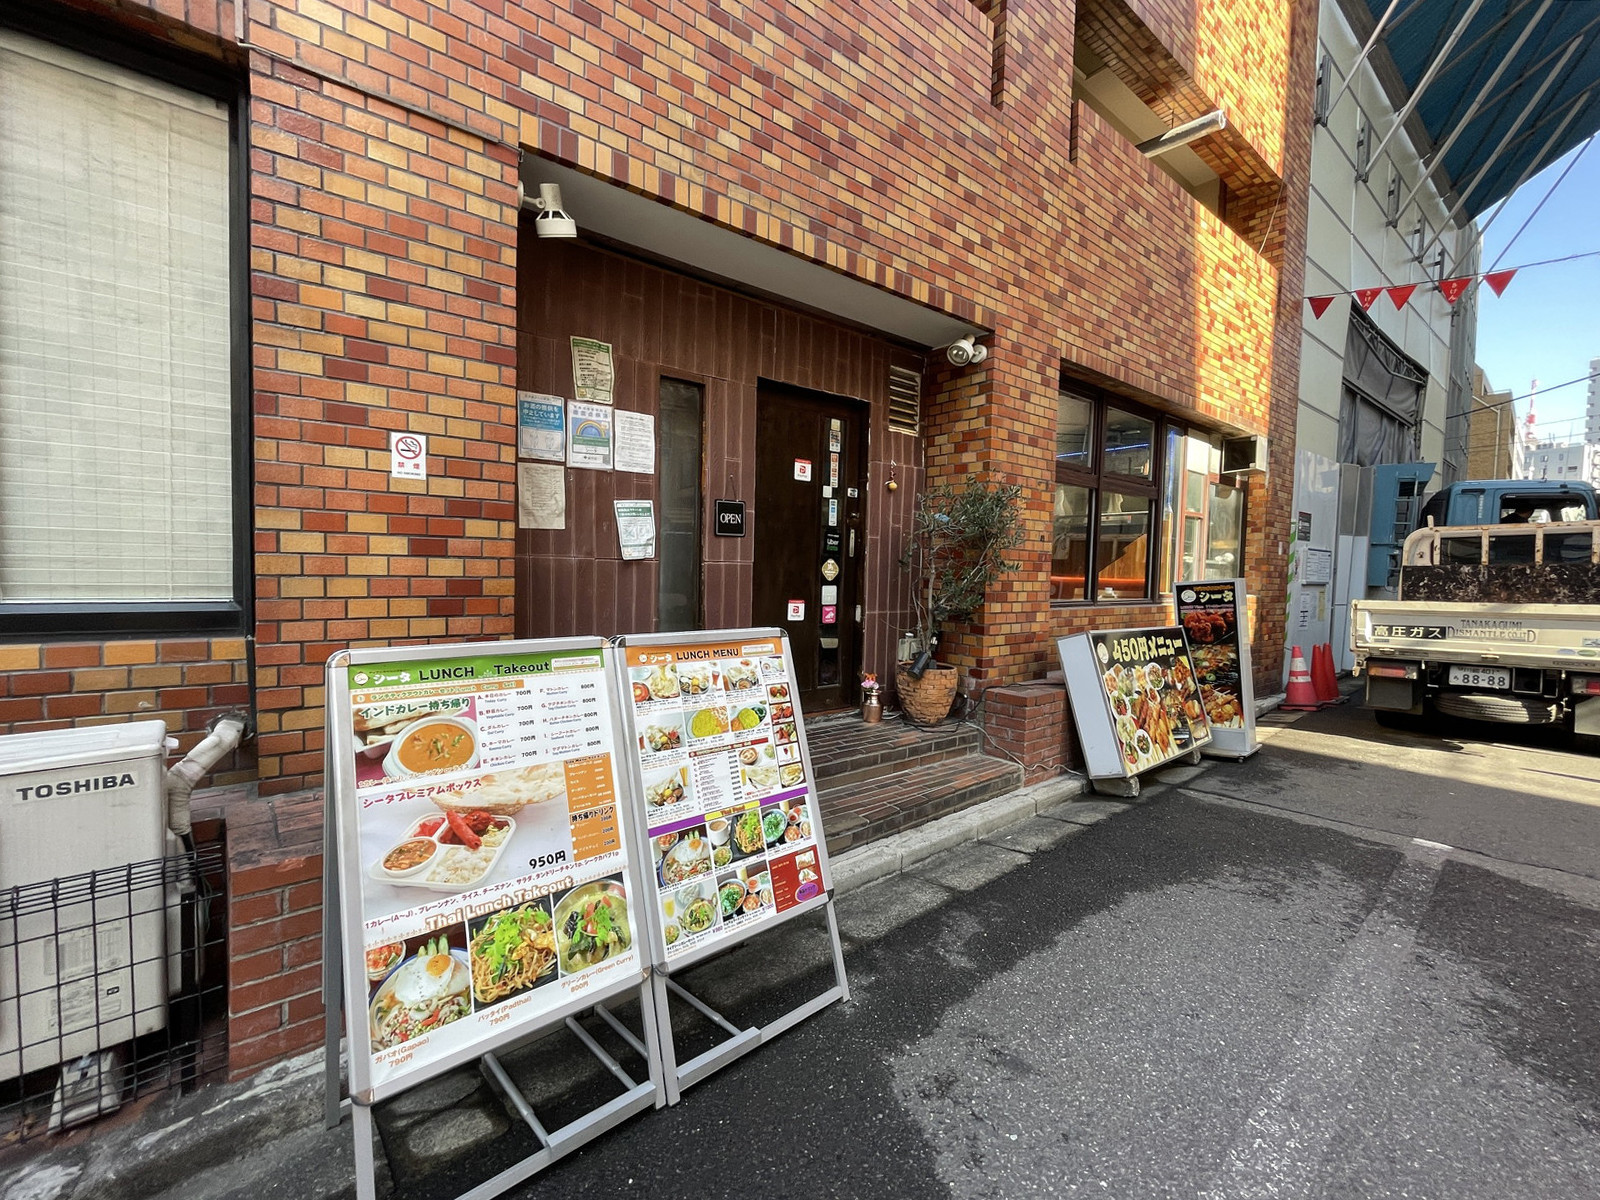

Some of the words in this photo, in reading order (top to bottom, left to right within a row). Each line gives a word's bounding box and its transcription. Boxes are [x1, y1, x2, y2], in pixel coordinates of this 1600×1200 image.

[720, 513, 742, 524] OPEN
[1199, 590, 1234, 602] シータ
[1461, 620, 1522, 630] TANAKAGUMI
[1374, 626, 1442, 638] 高圧ガス
[676, 650, 710, 660] LUNCH
[713, 648, 738, 656] MENU
[1112, 636, 1183, 662] 450円メニュー
[650, 653, 672, 663] シータ
[419, 666, 474, 680] LUNCH
[494, 662, 549, 674] Takeout
[373, 671, 411, 684] シータ
[1462, 673, 1506, 686] 88-88
[360, 698, 470, 718] インドカレー持ち帰り
[16, 773, 135, 801] TOSHIBA
[364, 779, 481, 808] シータプレミアムボックス
[529, 850, 566, 869] 950円
[426, 909, 463, 930] Thai
[465, 895, 512, 920] Lunch
[515, 876, 574, 903] Takeout
[616, 955, 634, 966] Curry)
[490, 1014, 510, 1026] 790円
[375, 1037, 430, 1064] ガパオ(Gapao)
[389, 1053, 412, 1067] 790円
